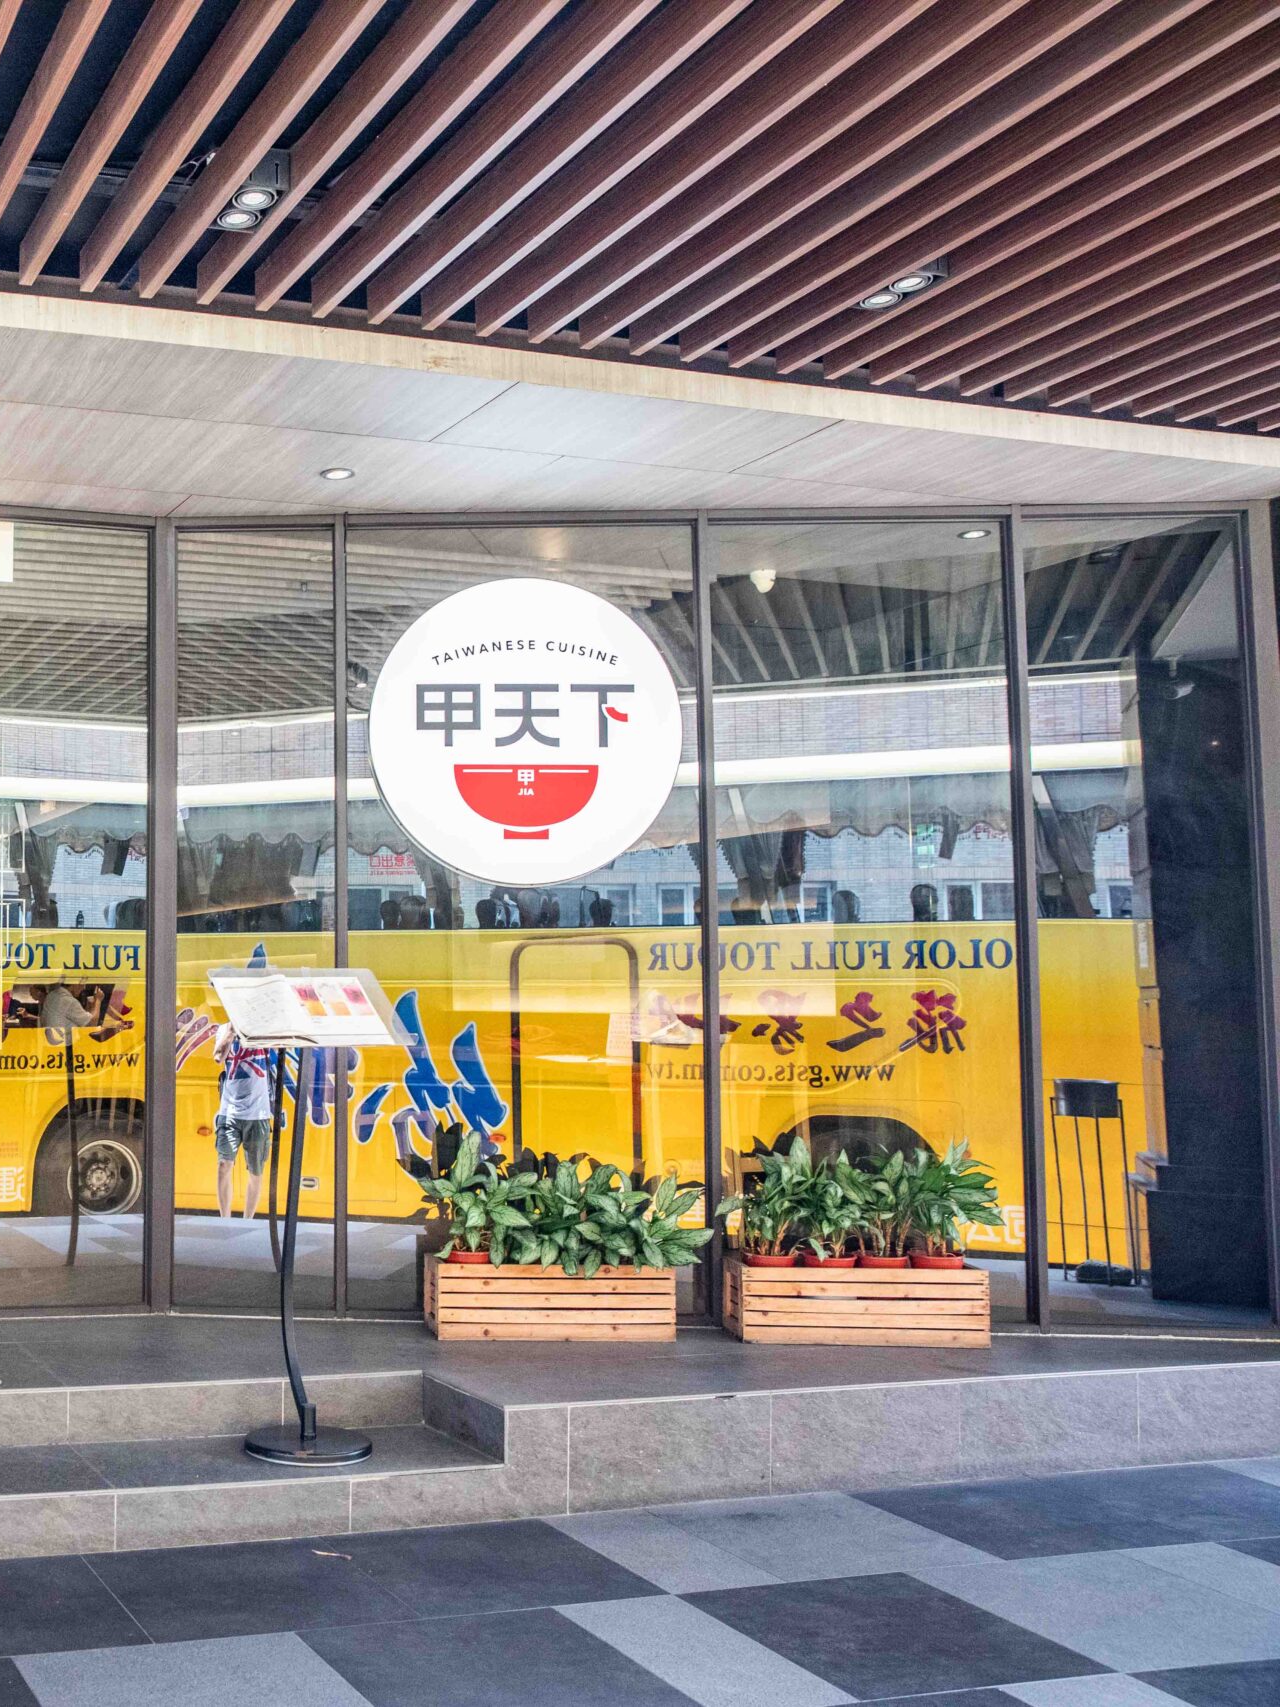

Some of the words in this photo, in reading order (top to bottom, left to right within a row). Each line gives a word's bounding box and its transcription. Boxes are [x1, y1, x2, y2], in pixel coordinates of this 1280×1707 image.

[431, 639, 536, 666] TAIWANESE
[545, 640, 619, 666] CUISINE
[416, 684, 634, 747] 甲天下
[517, 769, 535, 786] 甲
[518, 787, 535, 797] JIA
